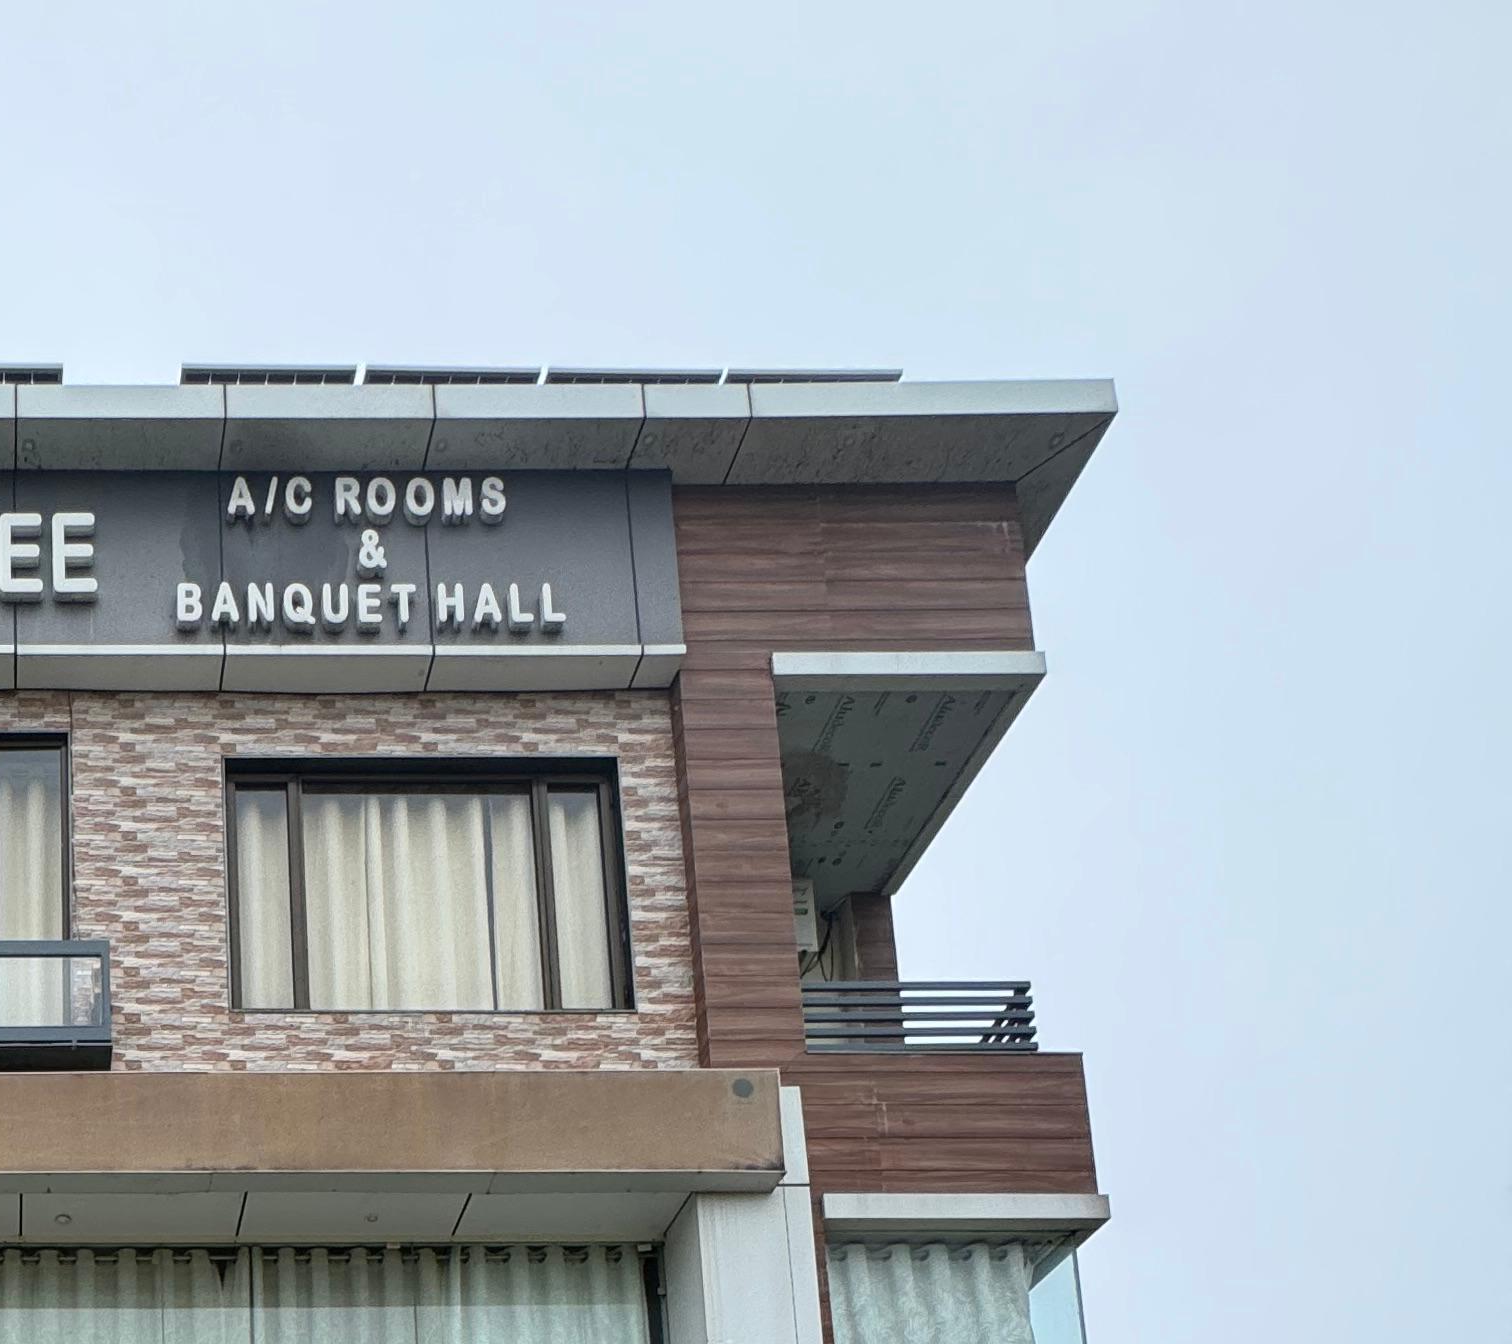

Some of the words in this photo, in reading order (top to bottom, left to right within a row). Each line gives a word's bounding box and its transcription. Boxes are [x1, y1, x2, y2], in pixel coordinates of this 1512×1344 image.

[228, 476, 313, 518] A/C
[334, 476, 507, 519] ROOMS
[358, 529, 388, 571] &
[176, 582, 417, 626] BANQUET
[437, 582, 567, 625] HALL
